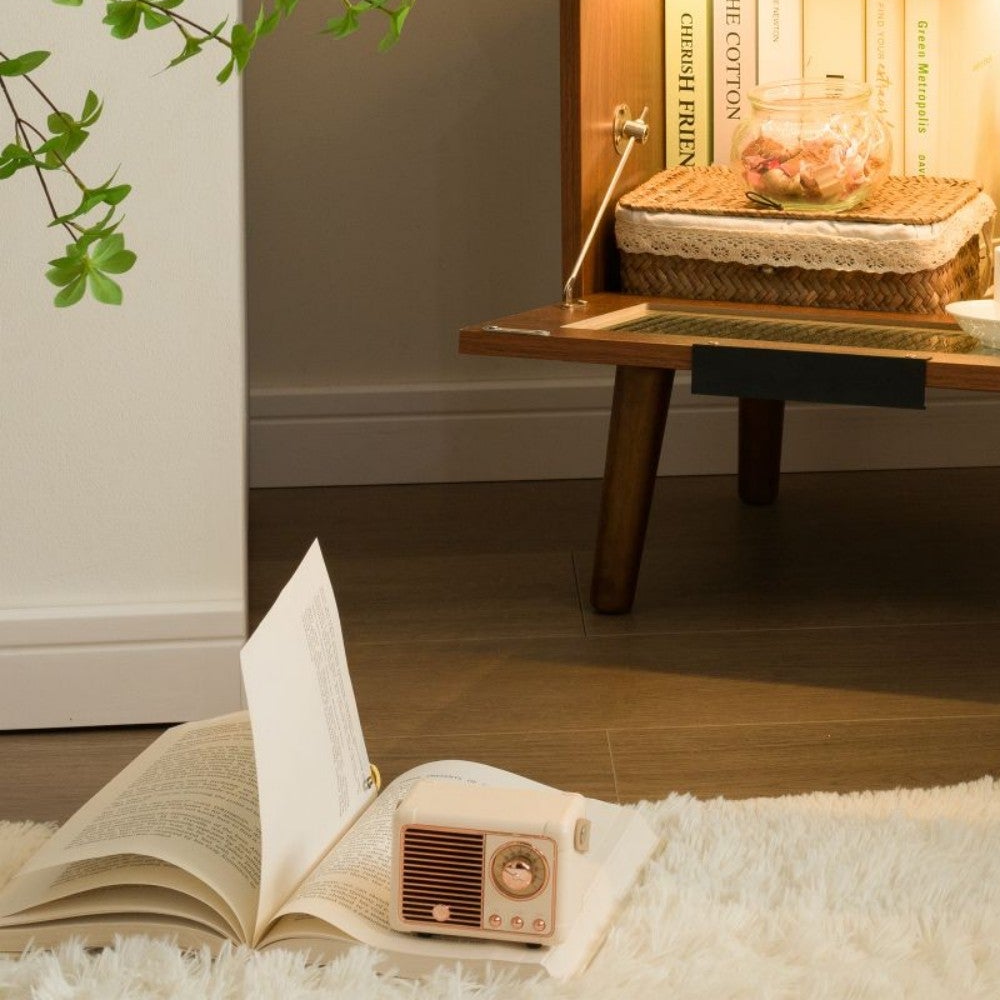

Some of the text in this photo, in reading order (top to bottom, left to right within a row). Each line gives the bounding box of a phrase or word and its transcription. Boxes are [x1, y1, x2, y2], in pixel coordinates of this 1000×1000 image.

[679, 13, 696, 93] CHERISH
[877, 31, 885, 60] YOUR
[917, 20, 929, 58] Green
[724, 31, 741, 121] COTTON
[917, 63, 930, 134] Metropolis
